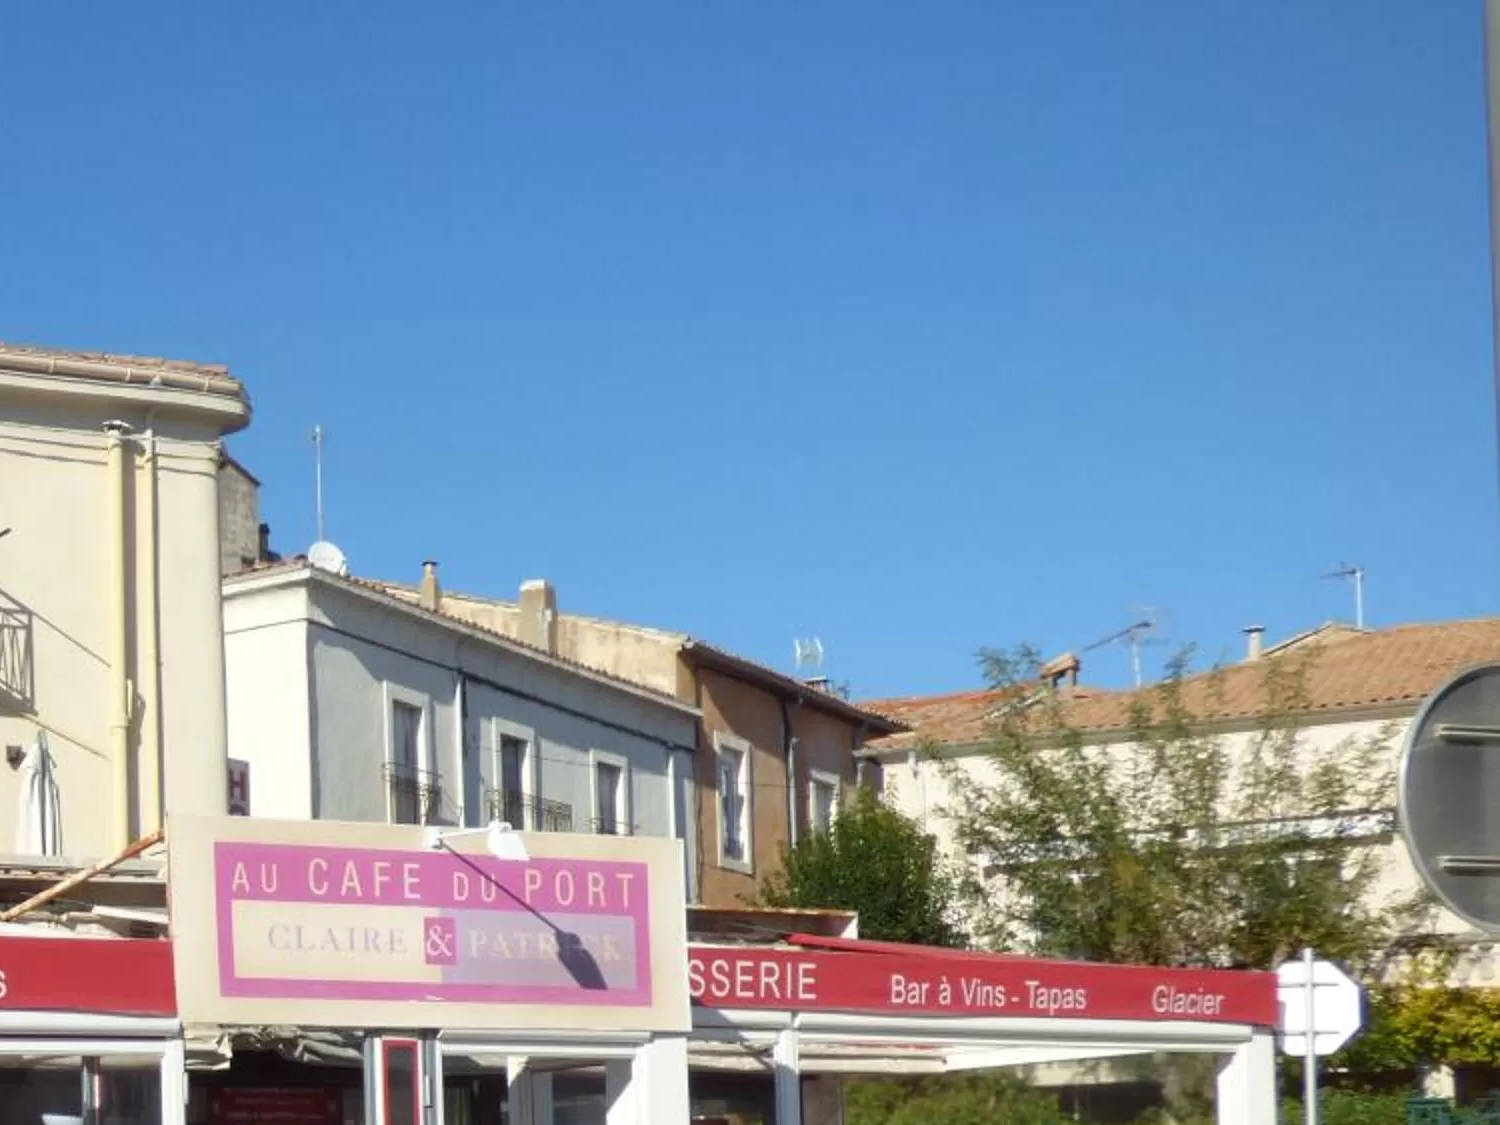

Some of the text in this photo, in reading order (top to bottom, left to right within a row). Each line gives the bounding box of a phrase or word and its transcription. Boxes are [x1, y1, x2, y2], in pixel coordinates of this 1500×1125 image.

[232, 857, 634, 908] AU CAFE DU PORT
[268, 923, 621, 961] CLAIRE & PATRK
[688, 959, 817, 999] SSERIE
[891, 974, 930, 1005] Bar
[939, 975, 951, 1005] à
[1024, 981, 1087, 1015] Tapas
[1152, 985, 1226, 1015] Glacier
